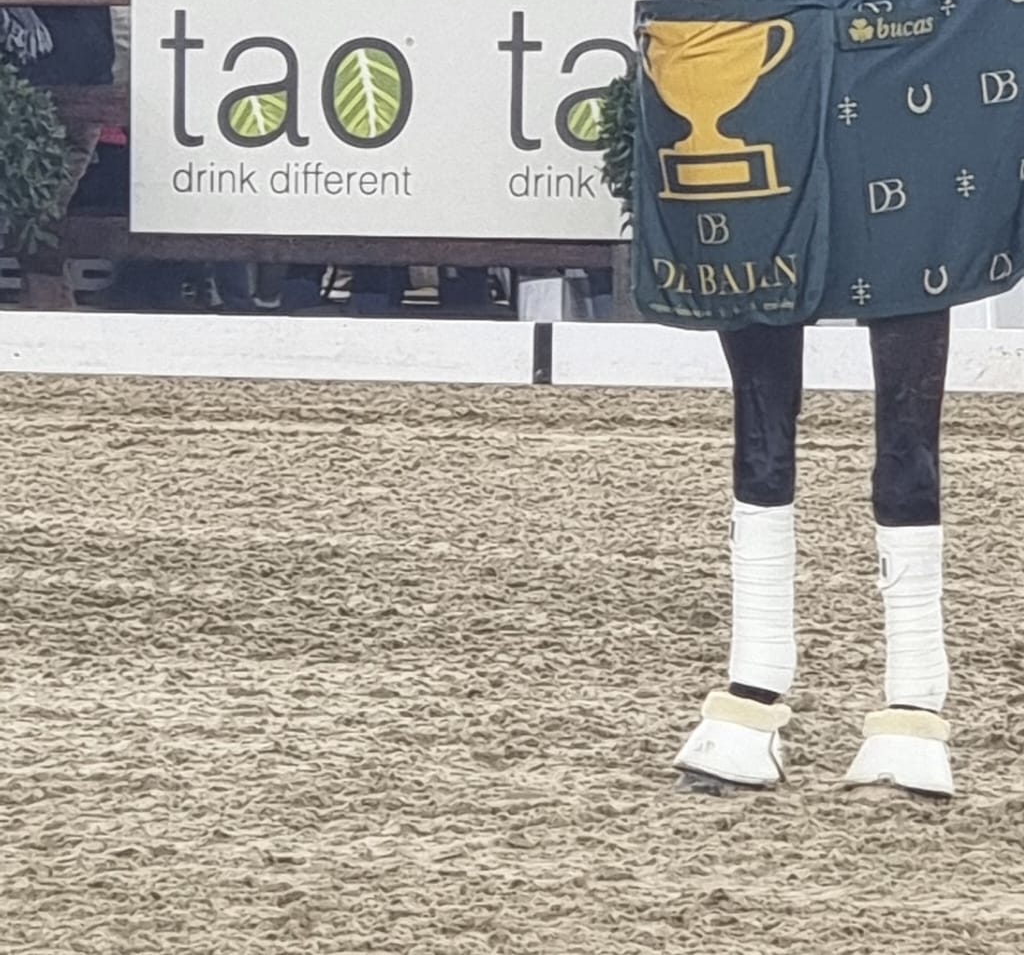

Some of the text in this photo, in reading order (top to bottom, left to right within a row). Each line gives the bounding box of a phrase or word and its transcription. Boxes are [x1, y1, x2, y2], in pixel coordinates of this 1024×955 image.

[877, 16, 935, 39] bucas
[160, 10, 413, 149] tao
[498, 11, 637, 151] ta
[981, 69, 1018, 105] DB
[172, 162, 412, 196] drink different
[509, 165, 596, 198] drink
[868, 178, 906, 214] DB
[697, 213, 729, 244] DB
